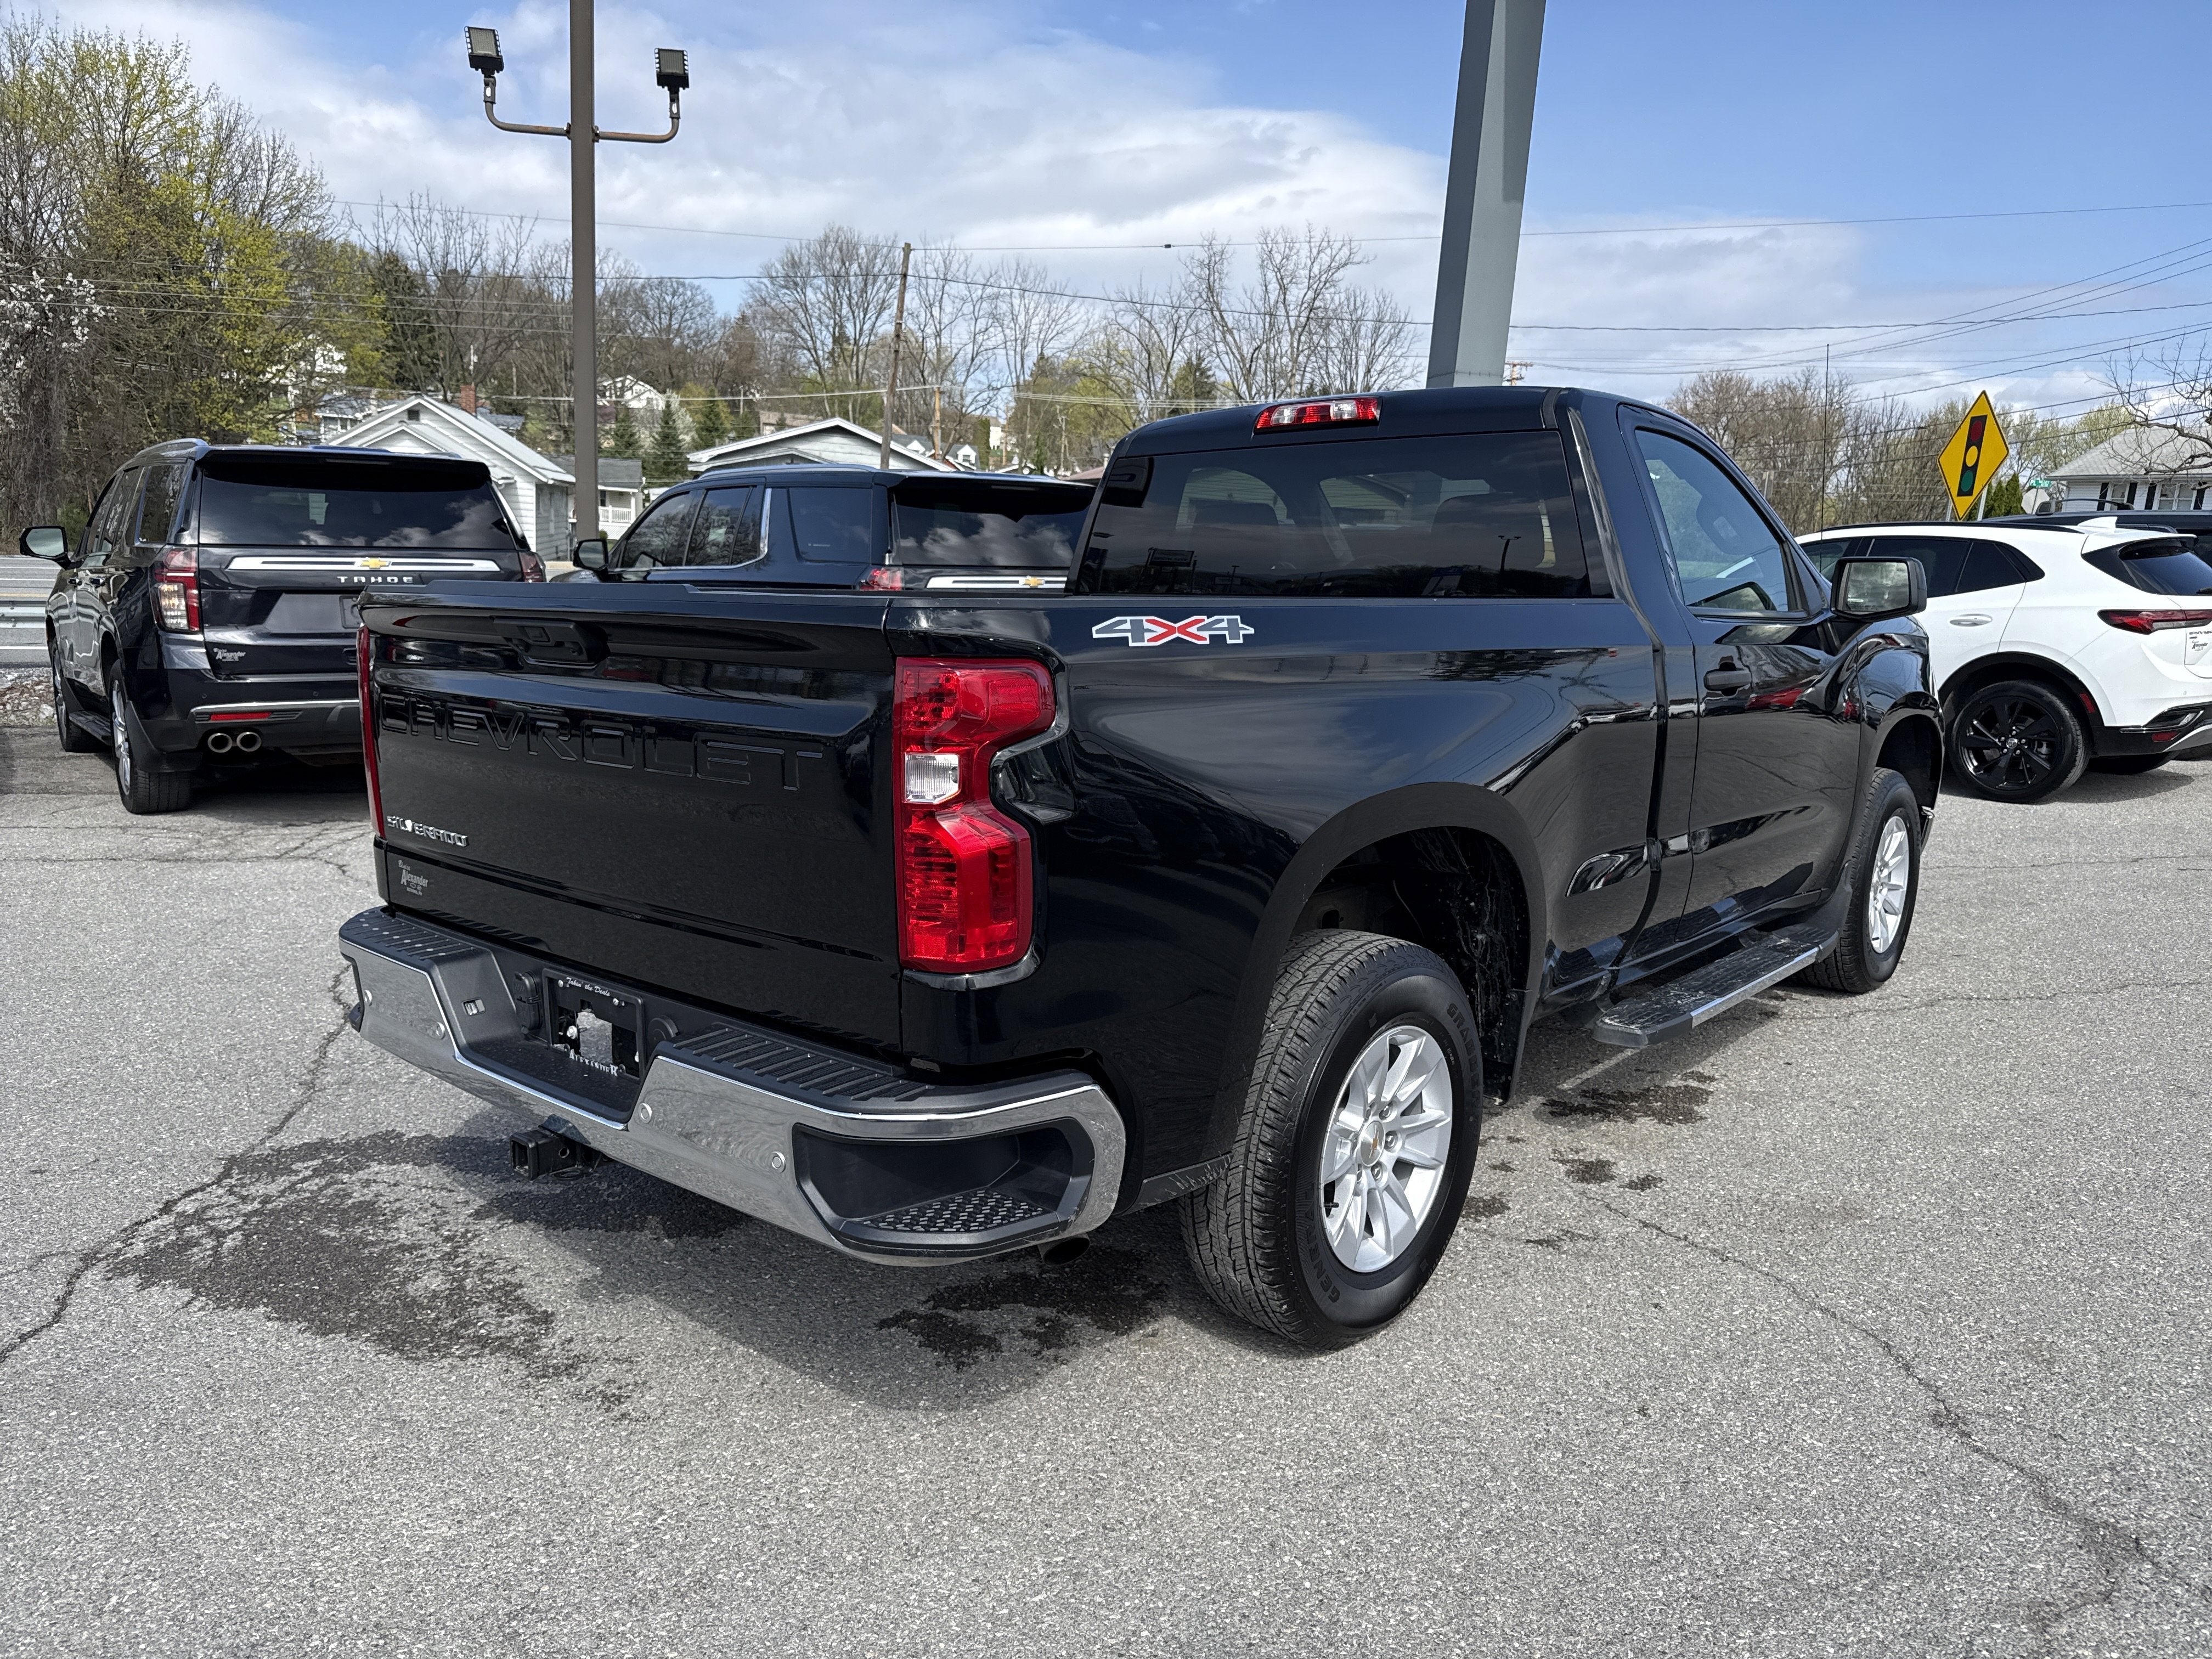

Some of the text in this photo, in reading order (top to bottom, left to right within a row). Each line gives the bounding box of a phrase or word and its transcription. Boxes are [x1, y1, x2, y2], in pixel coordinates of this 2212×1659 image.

[379, 693, 824, 792] CHEVROLET
[387, 815, 469, 847] SILVERADO
[400, 869, 429, 888] Alexander
[584, 983, 594, 991] the
[594, 986, 611, 997] Deals
[1304, 1181, 1341, 1304] GENERAL
